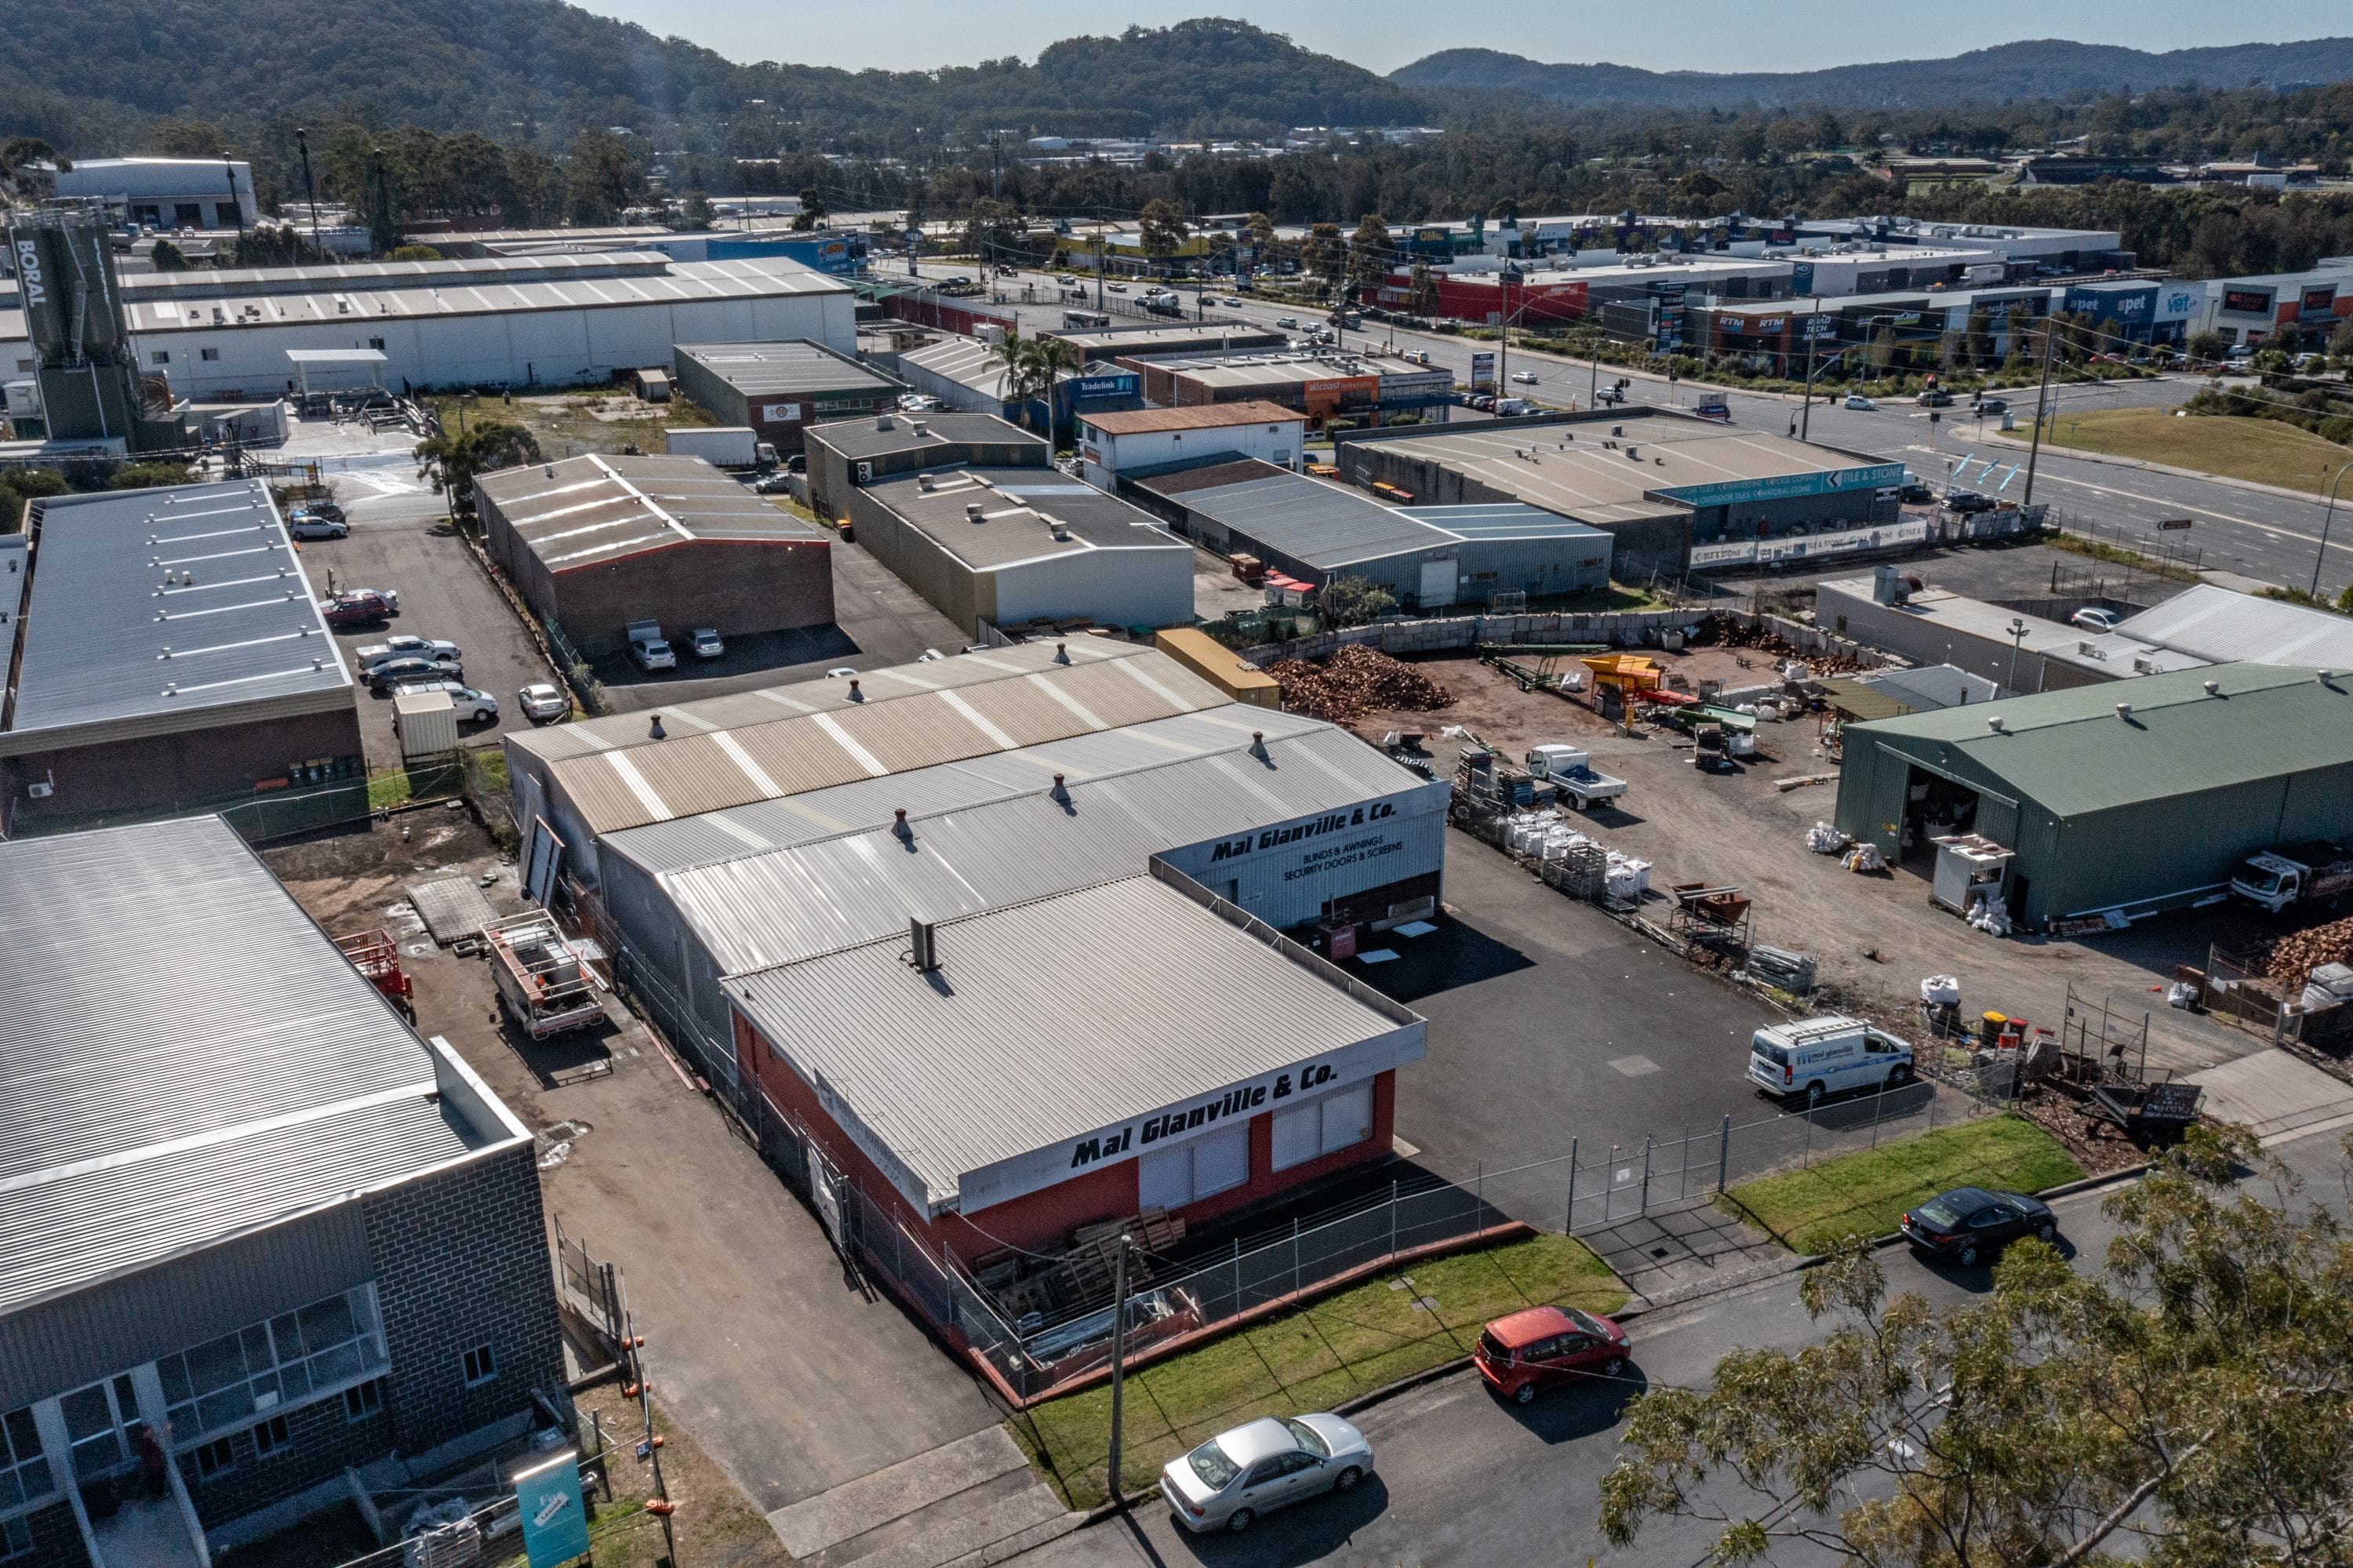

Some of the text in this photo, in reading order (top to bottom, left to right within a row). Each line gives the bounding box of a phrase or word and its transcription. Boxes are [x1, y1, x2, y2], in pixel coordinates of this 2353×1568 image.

[16, 240, 46, 307] BORAL
[2167, 293, 2191, 314] vet
[1719, 317, 1744, 326] RTM
[1759, 318, 1785, 327] RTM
[1807, 315, 1831, 326] RAD
[1081, 380, 1115, 391] Tradelink
[1309, 381, 1340, 391] allcoast
[1844, 472, 1860, 482] TILE
[1863, 471, 1869, 481] &
[1872, 467, 1902, 480] STONE
[1721, 549, 1741, 558] STONE
[1211, 802, 1397, 863] Mal Glanville & Co.
[1304, 835, 1384, 864] BLINDS & AWNINGS
[1283, 842, 1403, 882] SECURITY DOORS & SCREENS
[1812, 1051, 1824, 1060] mal
[1071, 1064, 1338, 1169] Mal Glanville & Co.
[540, 1499, 562, 1520] Leased
